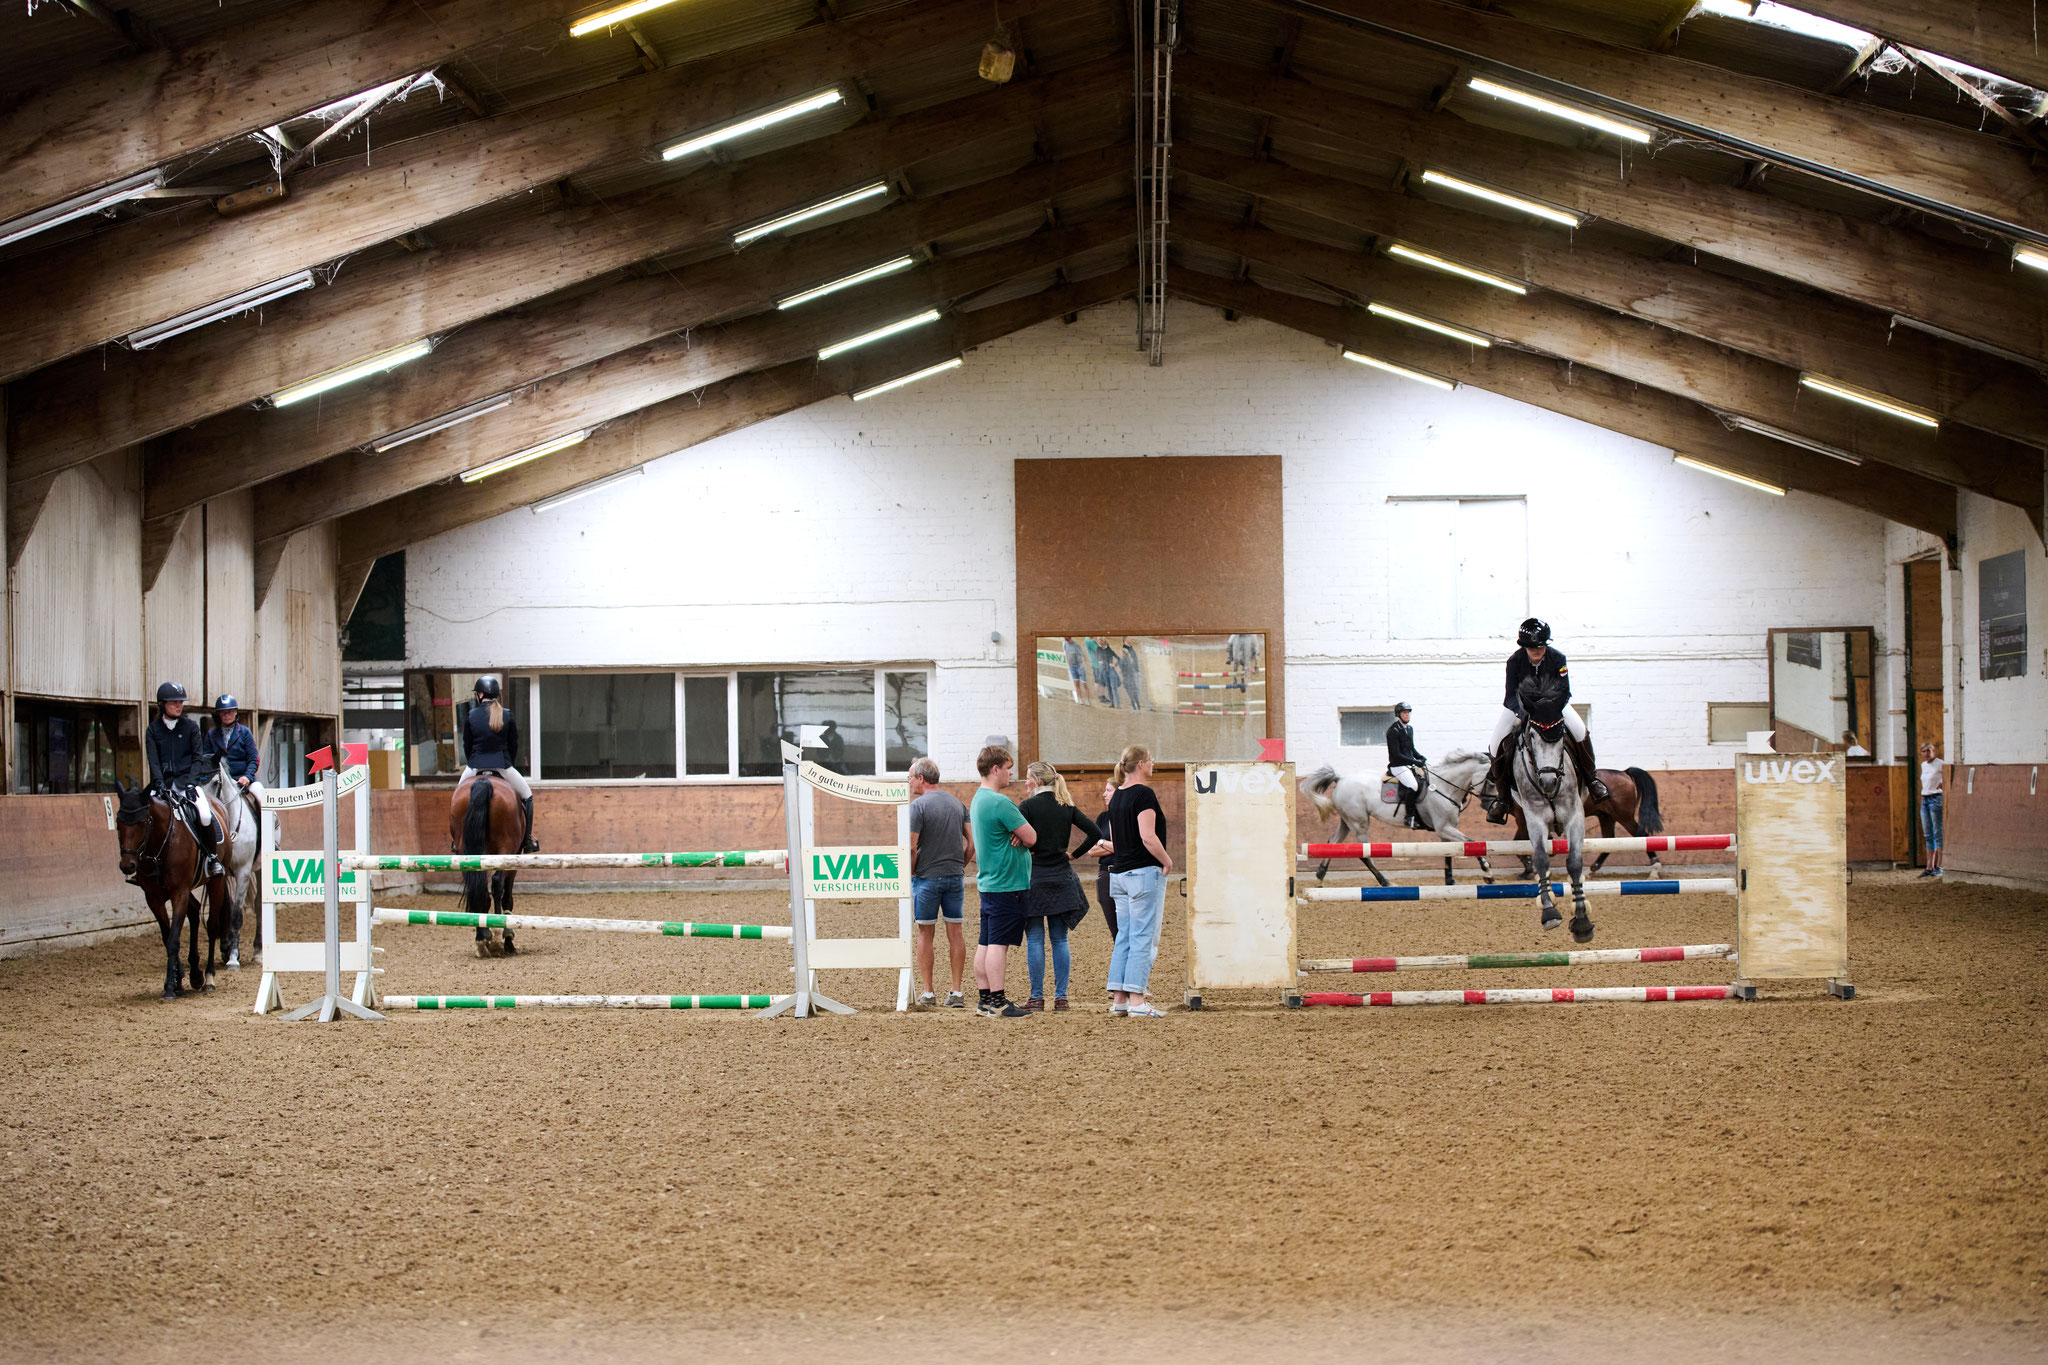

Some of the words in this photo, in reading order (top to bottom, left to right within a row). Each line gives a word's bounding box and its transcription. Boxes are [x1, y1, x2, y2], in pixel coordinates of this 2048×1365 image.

[808, 767, 818, 778] In
[819, 775, 844, 790] guten
[846, 784, 883, 797] Händen.
[886, 788, 906, 797] LVM
[1195, 770, 1287, 794] uvex
[1745, 760, 1836, 784] uvex
[266, 795, 275, 804] In
[278, 792, 304, 805] guten
[343, 770, 362, 786] LVM
[272, 858, 325, 884] LVM
[813, 854, 870, 881] LVM
[272, 886, 357, 896] VERSICHENG
[814, 882, 900, 893] VERSICHERUNG
